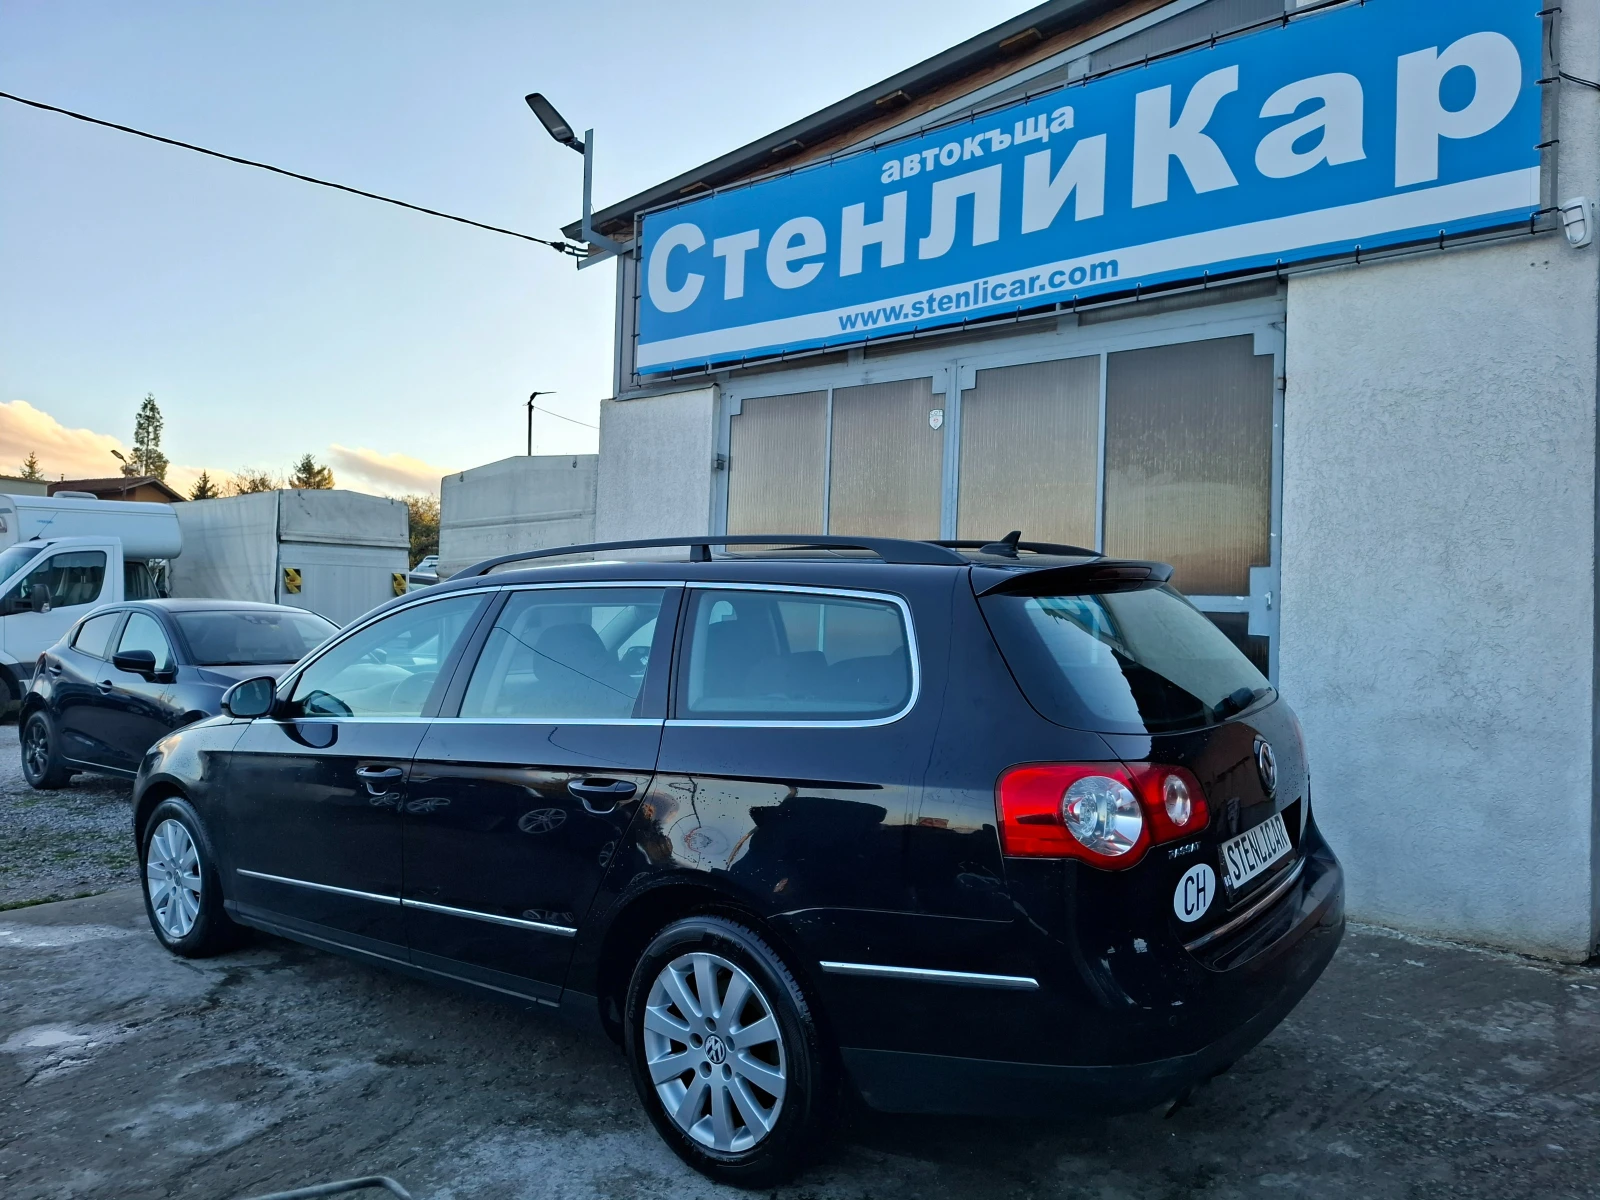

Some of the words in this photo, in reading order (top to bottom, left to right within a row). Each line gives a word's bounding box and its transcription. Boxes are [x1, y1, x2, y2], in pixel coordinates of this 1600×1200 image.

[647, 31, 1522, 313] СтенлиКар
[881, 106, 1074, 183] автокъща
[839, 259, 1119, 331] www.stenlicar.com
[1227, 815, 1288, 880] STENLICAR
[1184, 869, 1207, 916] CH
